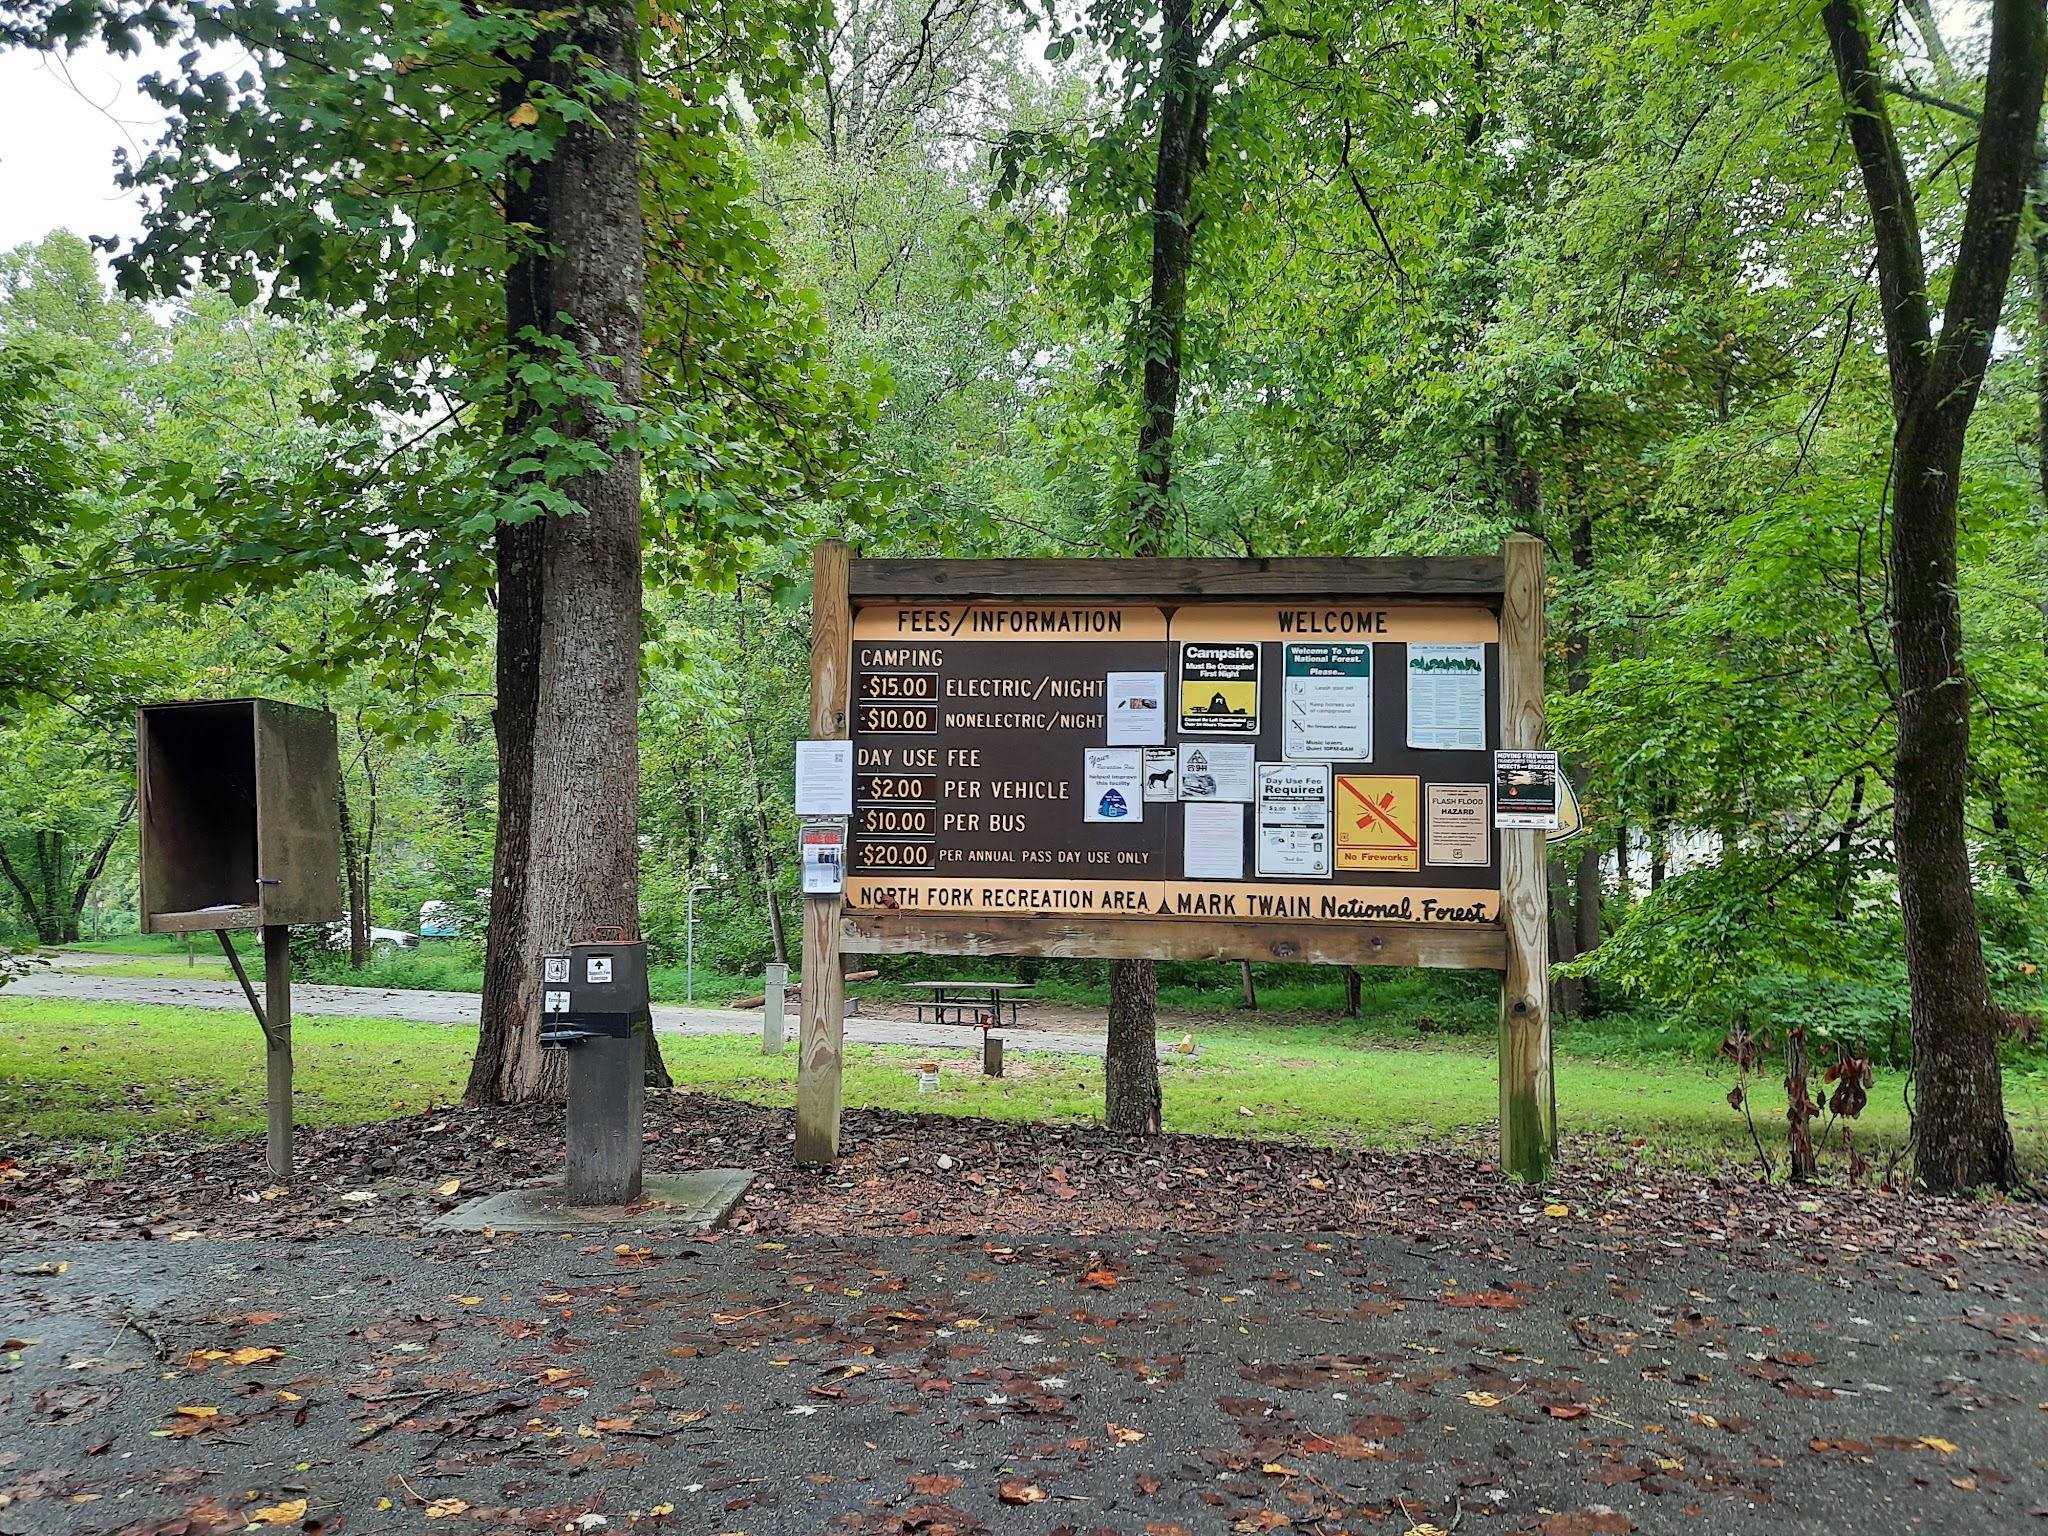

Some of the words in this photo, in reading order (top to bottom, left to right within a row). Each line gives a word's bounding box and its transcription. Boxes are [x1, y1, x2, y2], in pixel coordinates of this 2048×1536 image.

[898, 610, 1121, 637] FEES/INFORMATION
[1278, 611, 1388, 633] WELCOME
[861, 649, 943, 667] CAMPING
[1186, 646, 1255, 662] Campsite
[1290, 647, 1329, 655] Welcome
[1331, 647, 1343, 655] To
[1345, 647, 1365, 655] Your
[1294, 655, 1329, 663] National
[1185, 662, 1205, 670] Must
[1217, 663, 1255, 672] Occupied
[1218, 670, 1240, 678] Night
[869, 677, 928, 698] $15.00
[945, 676, 1105, 701] ELECTRIC/NIGHT
[867, 710, 928, 730] $10.00
[945, 711, 1105, 732] NONELECTRIC/NIGHT
[858, 749, 893, 768] DAY
[903, 749, 938, 767] USE
[948, 749, 981, 767] FEE
[1088, 755, 1110, 768] Your
[870, 777, 922, 799] $2.00
[944, 781, 980, 798] PER
[992, 781, 1070, 800] VEHICLE
[1264, 784, 1324, 796] Required
[1265, 777, 1283, 786] Day
[865, 811, 926, 832] $10.00
[944, 814, 980, 832] PER
[989, 814, 1027, 833] BUS
[1289, 830, 1296, 838] 2
[864, 844, 927, 866] $20.00
[1290, 842, 1296, 850] 3
[939, 850, 963, 862] PER
[968, 851, 1016, 862] ANNUAL
[1022, 851, 1053, 863] PASS
[1058, 851, 1082, 864] DAY
[1088, 852, 1111, 864] USE
[1117, 852, 1150, 865] ONLY
[1344, 853, 1358, 862] No
[1361, 853, 1409, 862] Fireworks
[861, 886, 918, 906] NORTH
[927, 888, 974, 907] FORK
[982, 889, 1093, 908] RECREATION
[1101, 891, 1149, 910] AREA
[1177, 893, 1237, 915] MARK
[1247, 895, 1310, 917] TWAIN
[1321, 896, 1412, 919] National
[1421, 899, 1487, 922] Forest
